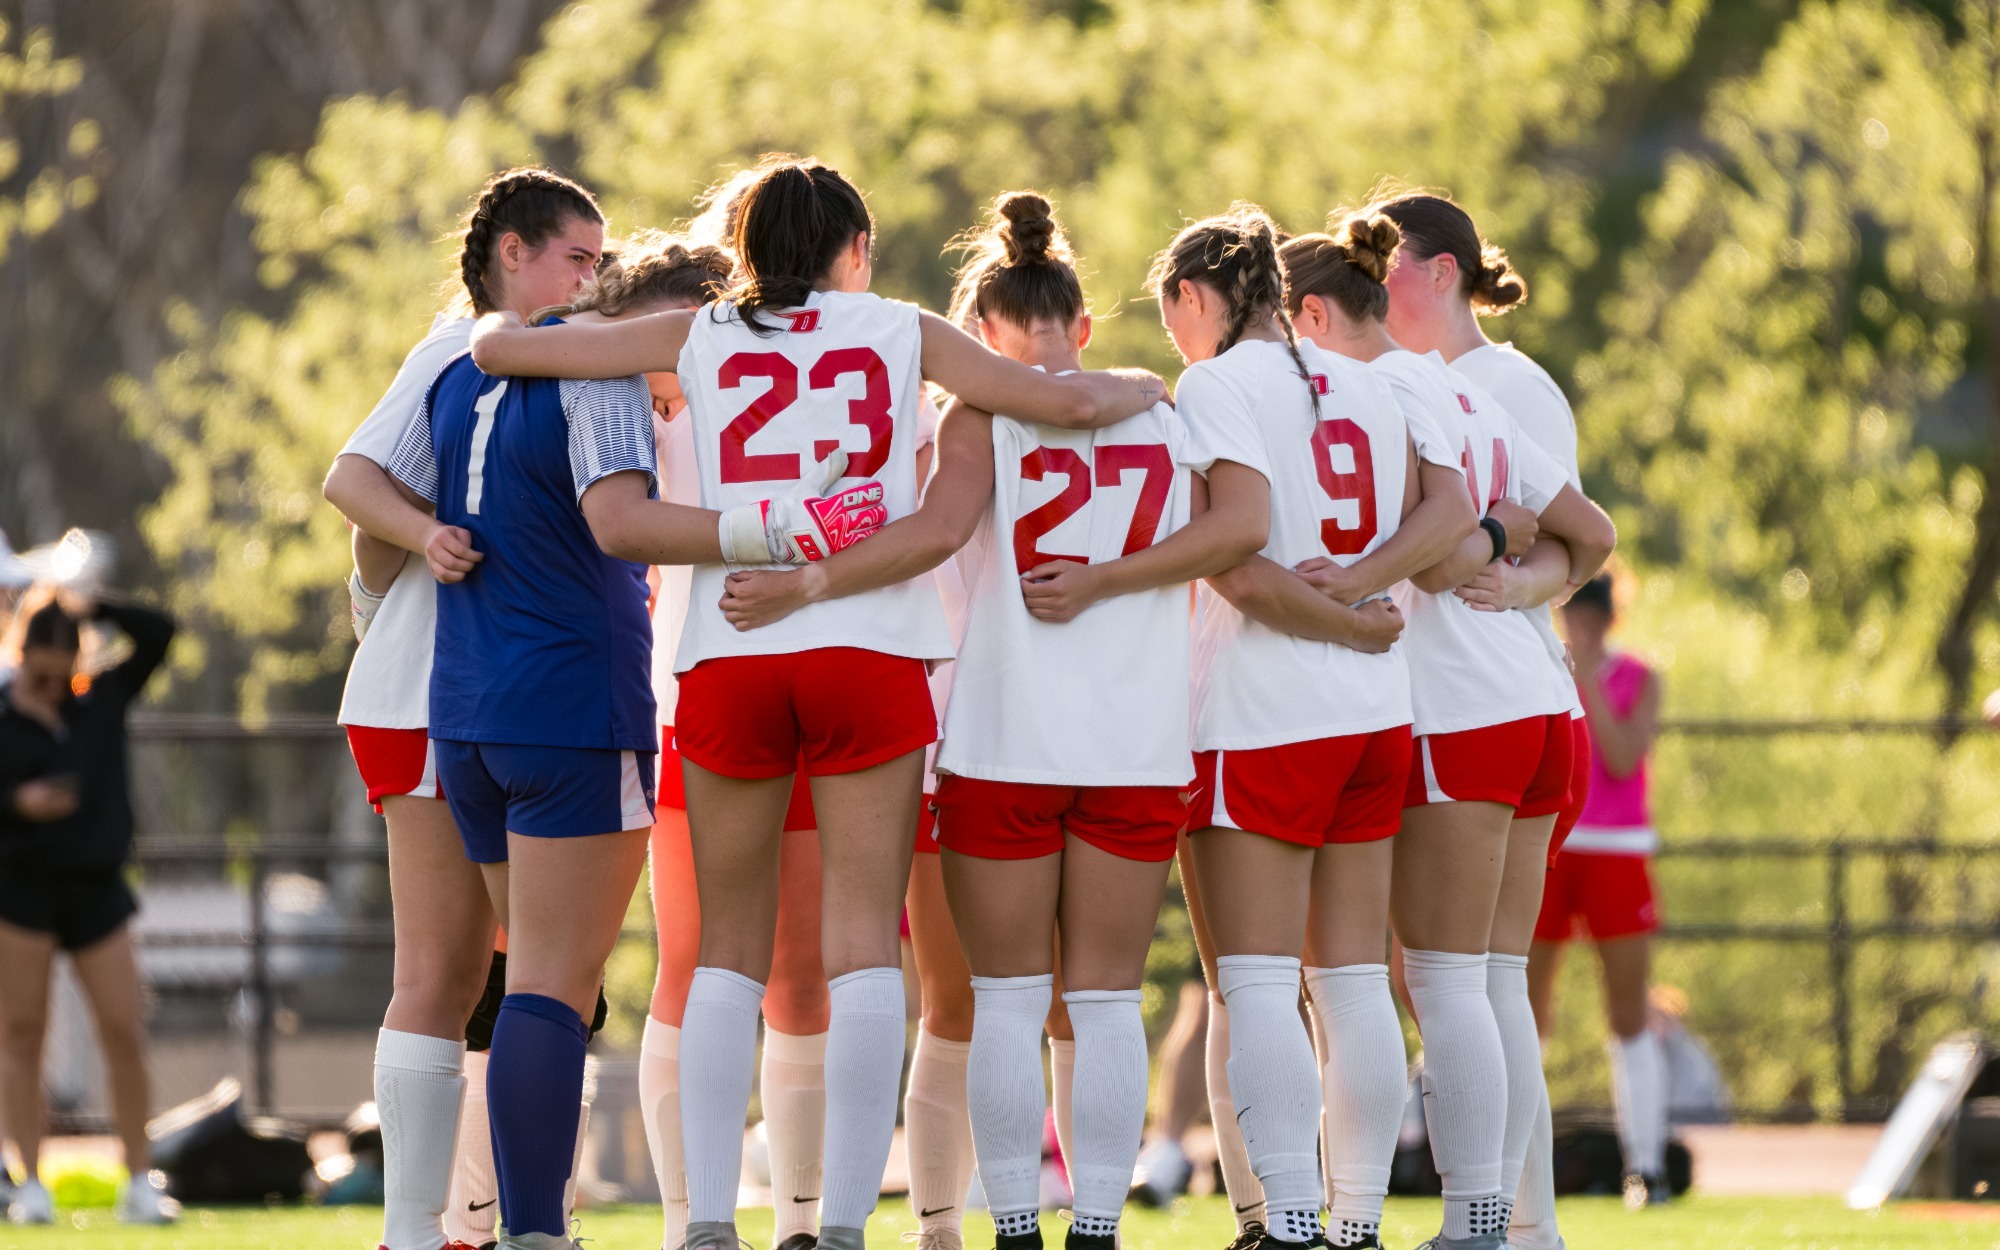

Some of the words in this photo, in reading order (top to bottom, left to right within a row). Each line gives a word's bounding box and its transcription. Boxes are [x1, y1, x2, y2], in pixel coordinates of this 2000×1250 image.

[466, 380, 507, 515] 1
[718, 347, 894, 485] 23
[843, 486, 883, 508] ONE
[1013, 443, 1175, 576] 27
[1310, 418, 1378, 556] 9
